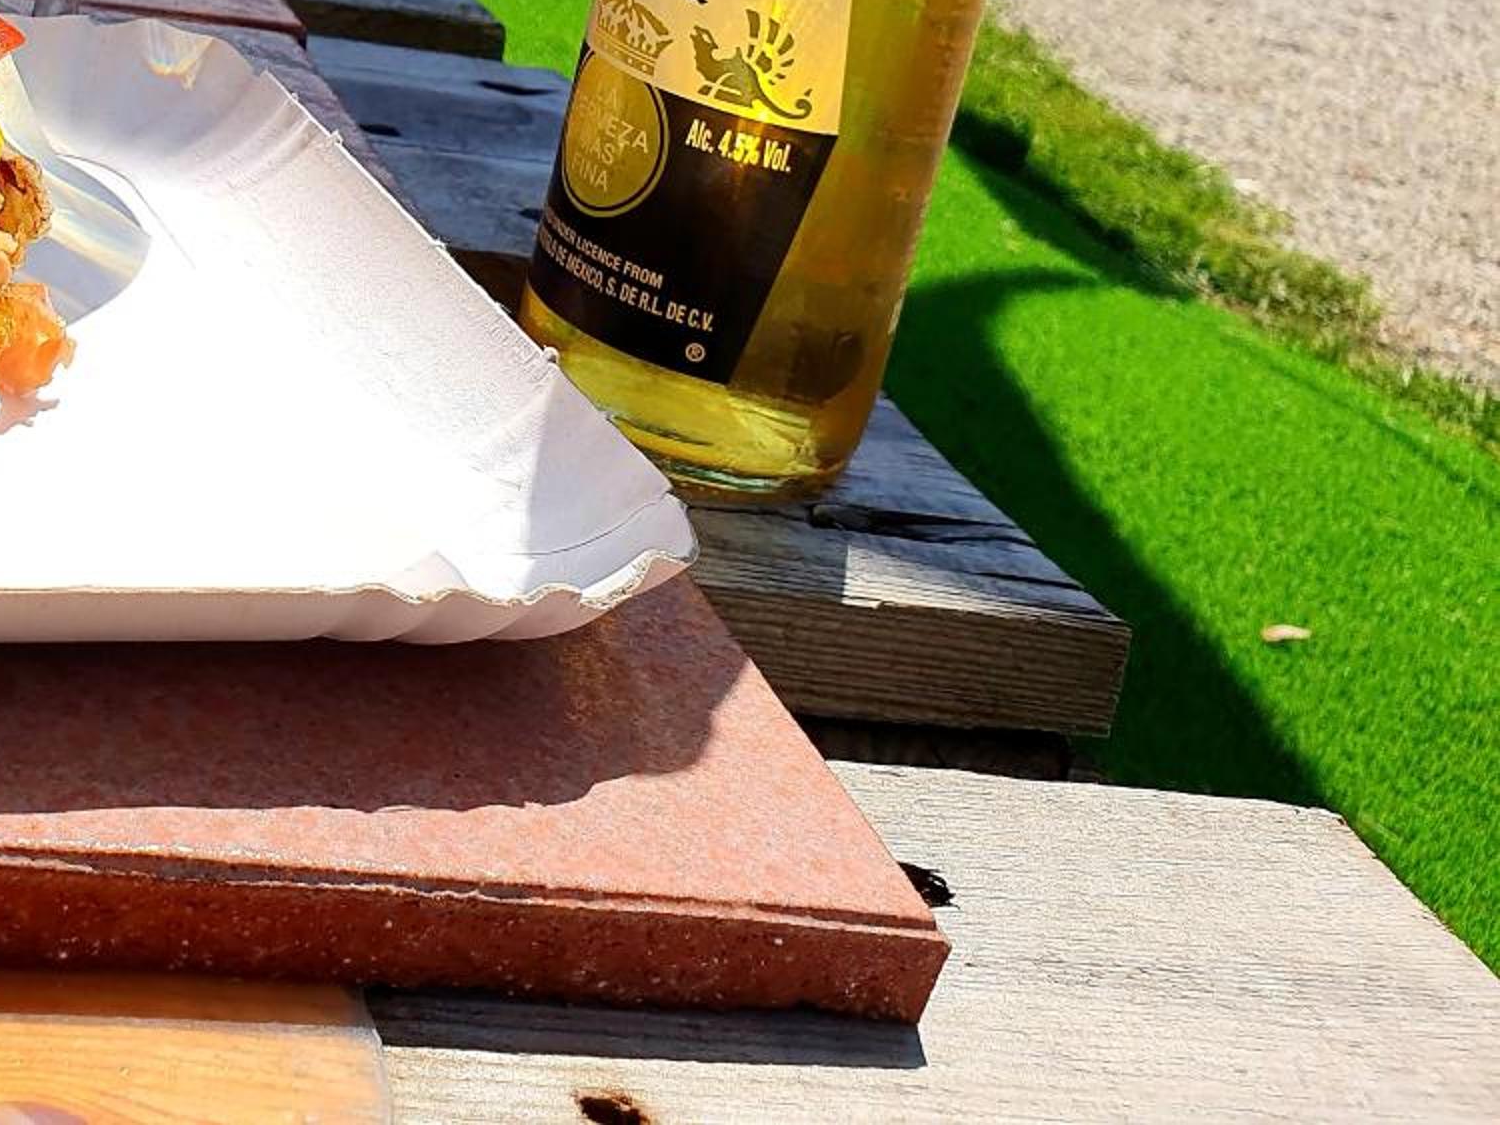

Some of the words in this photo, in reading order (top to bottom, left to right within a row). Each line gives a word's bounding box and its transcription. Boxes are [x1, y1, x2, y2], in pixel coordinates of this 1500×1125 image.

[685, 118, 715, 154] Alc.
[718, 129, 762, 166] 4.5%
[763, 139, 792, 172] Vol.
[623, 260, 663, 289] FROM
[619, 282, 639, 306] DE
[665, 300, 687, 324] DE
